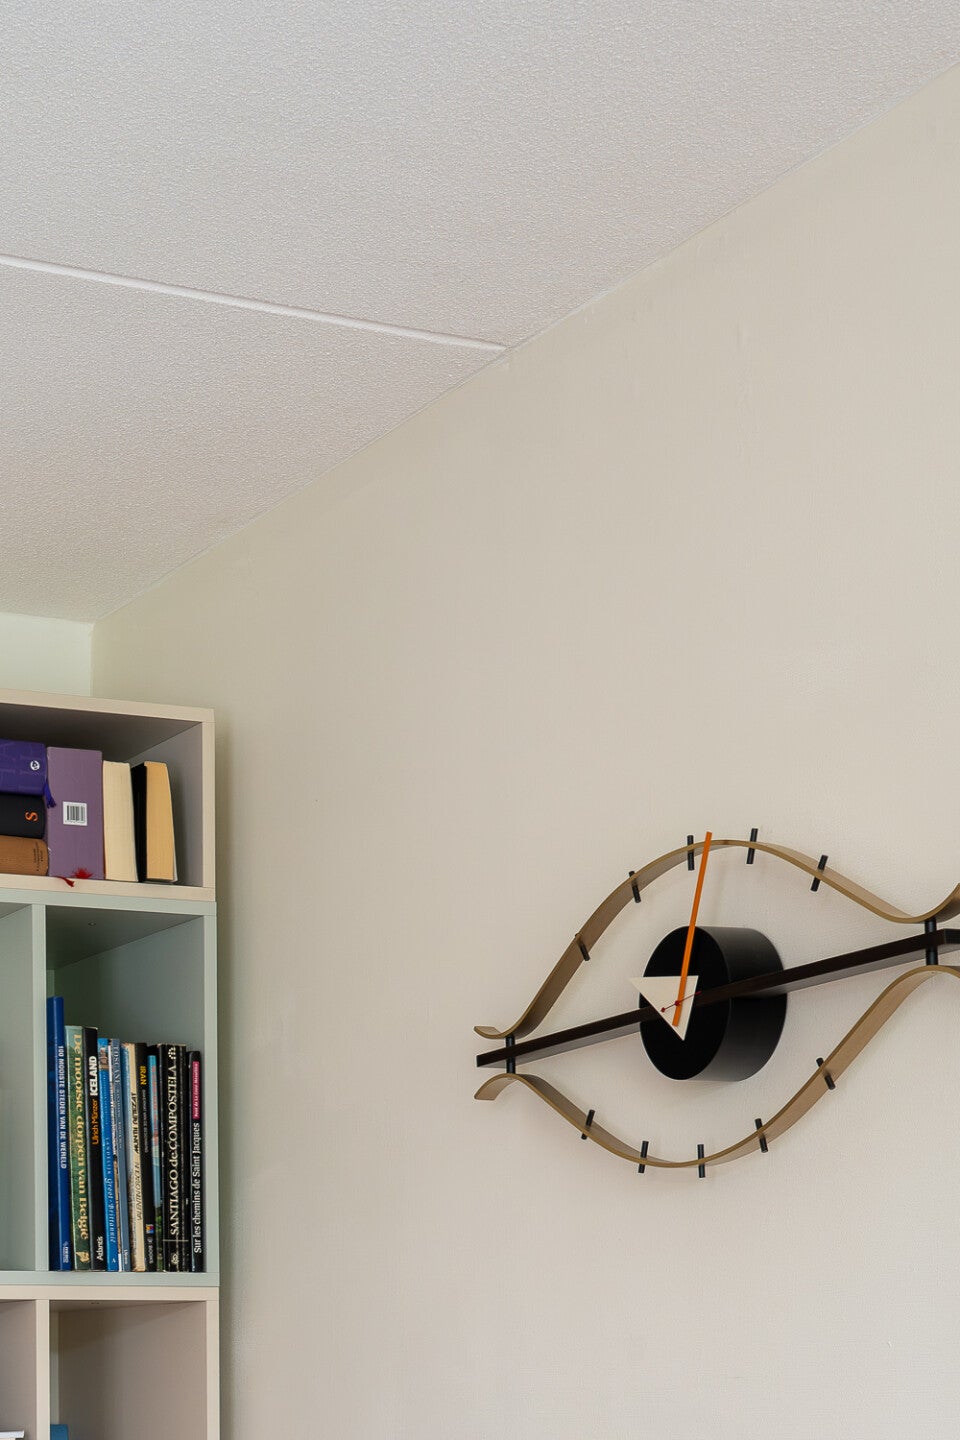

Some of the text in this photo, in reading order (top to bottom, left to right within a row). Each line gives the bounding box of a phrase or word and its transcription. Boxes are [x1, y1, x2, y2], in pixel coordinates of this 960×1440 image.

[88, 1055, 98, 1097] ICELAND
[139, 1066, 147, 1085] IRAN
[60, 1131, 66, 1140] DE
[73, 1033, 88, 1241] De mooiste dorpen van België
[166, 1065, 179, 1236] SANTIAGO de COMPOSTELA
[190, 1122, 203, 1254] Sur les chemins de Saint Jacques
[95, 1236, 104, 1261] Atlantis
